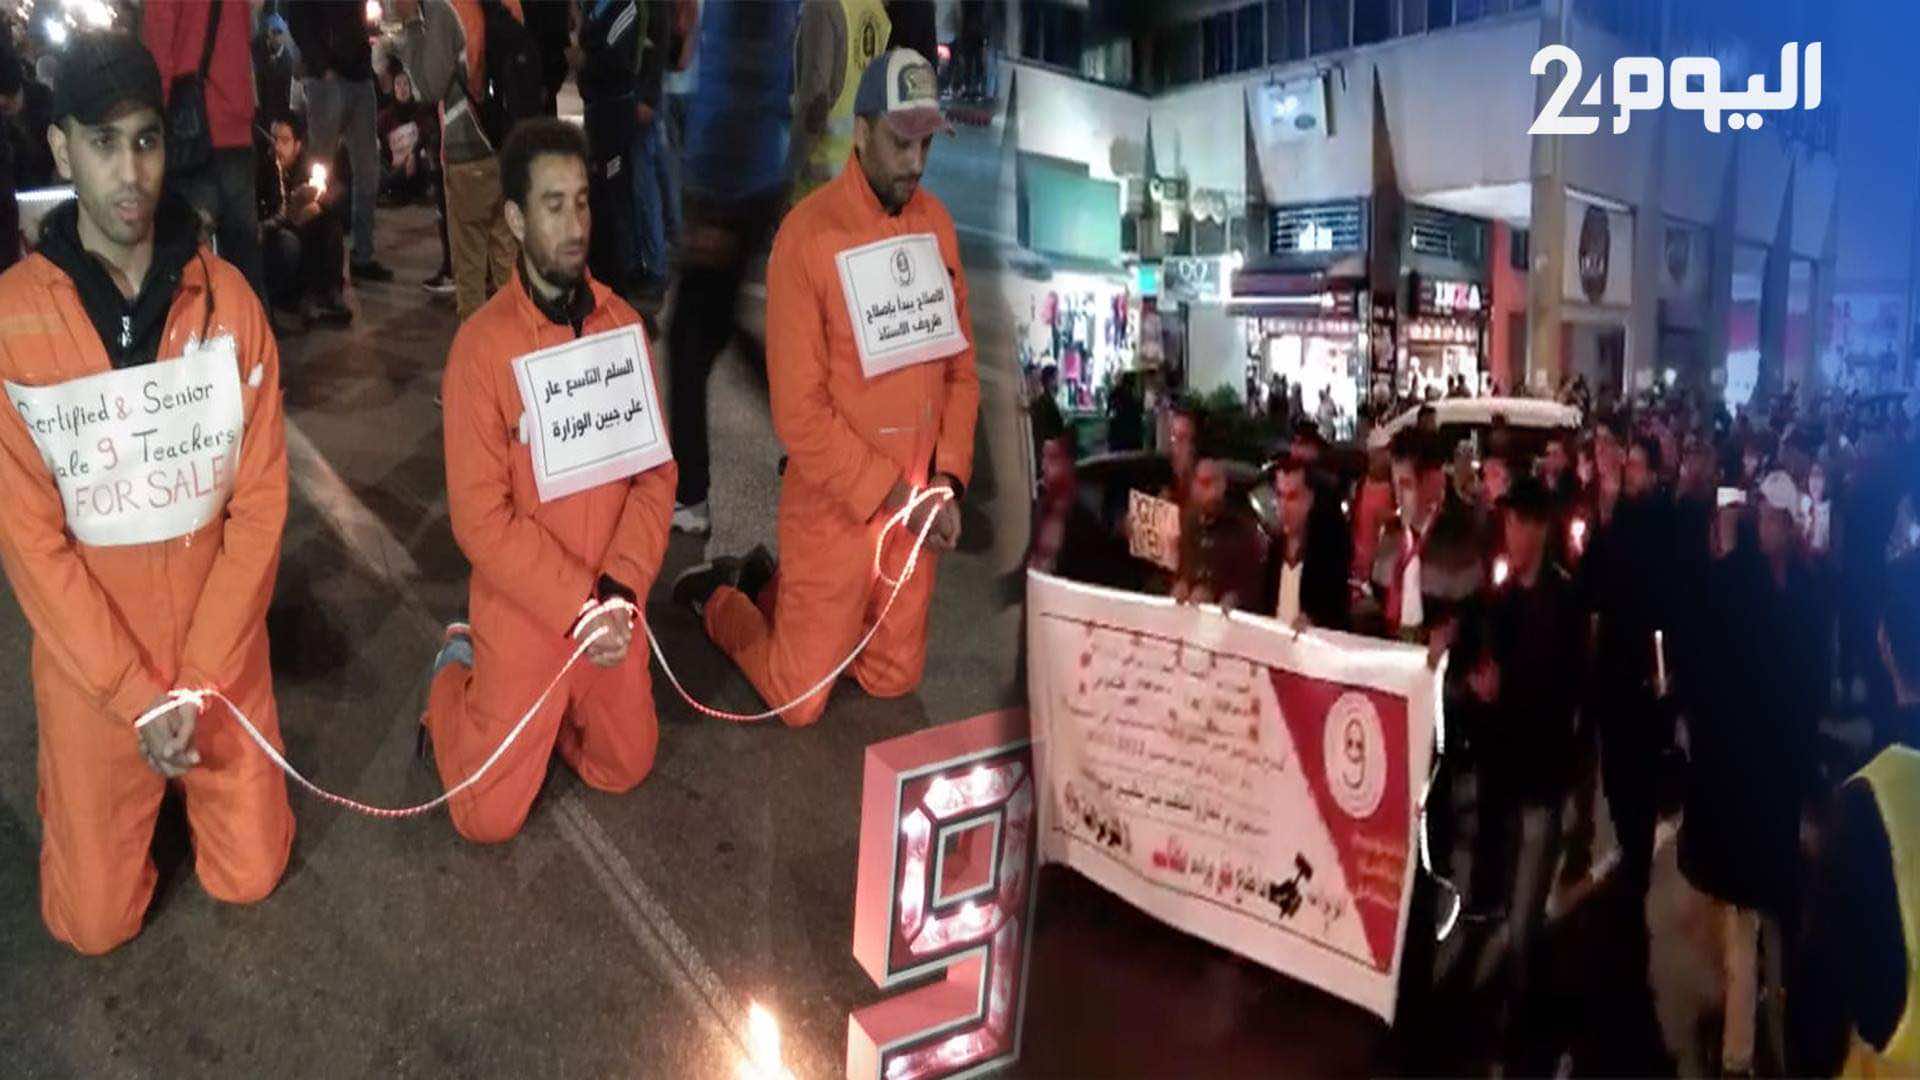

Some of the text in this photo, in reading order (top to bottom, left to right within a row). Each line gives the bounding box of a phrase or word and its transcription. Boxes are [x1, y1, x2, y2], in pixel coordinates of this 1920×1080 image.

[115, 396, 132, 421] &
[142, 380, 214, 415] Senior
[544, 357, 635, 404] السلم التاسع عار
[552, 398, 643, 442] على جبين الوزارة
[56, 452, 90, 479] ale
[131, 422, 236, 463] Teachers
[74, 455, 227, 517] FOR SALE
